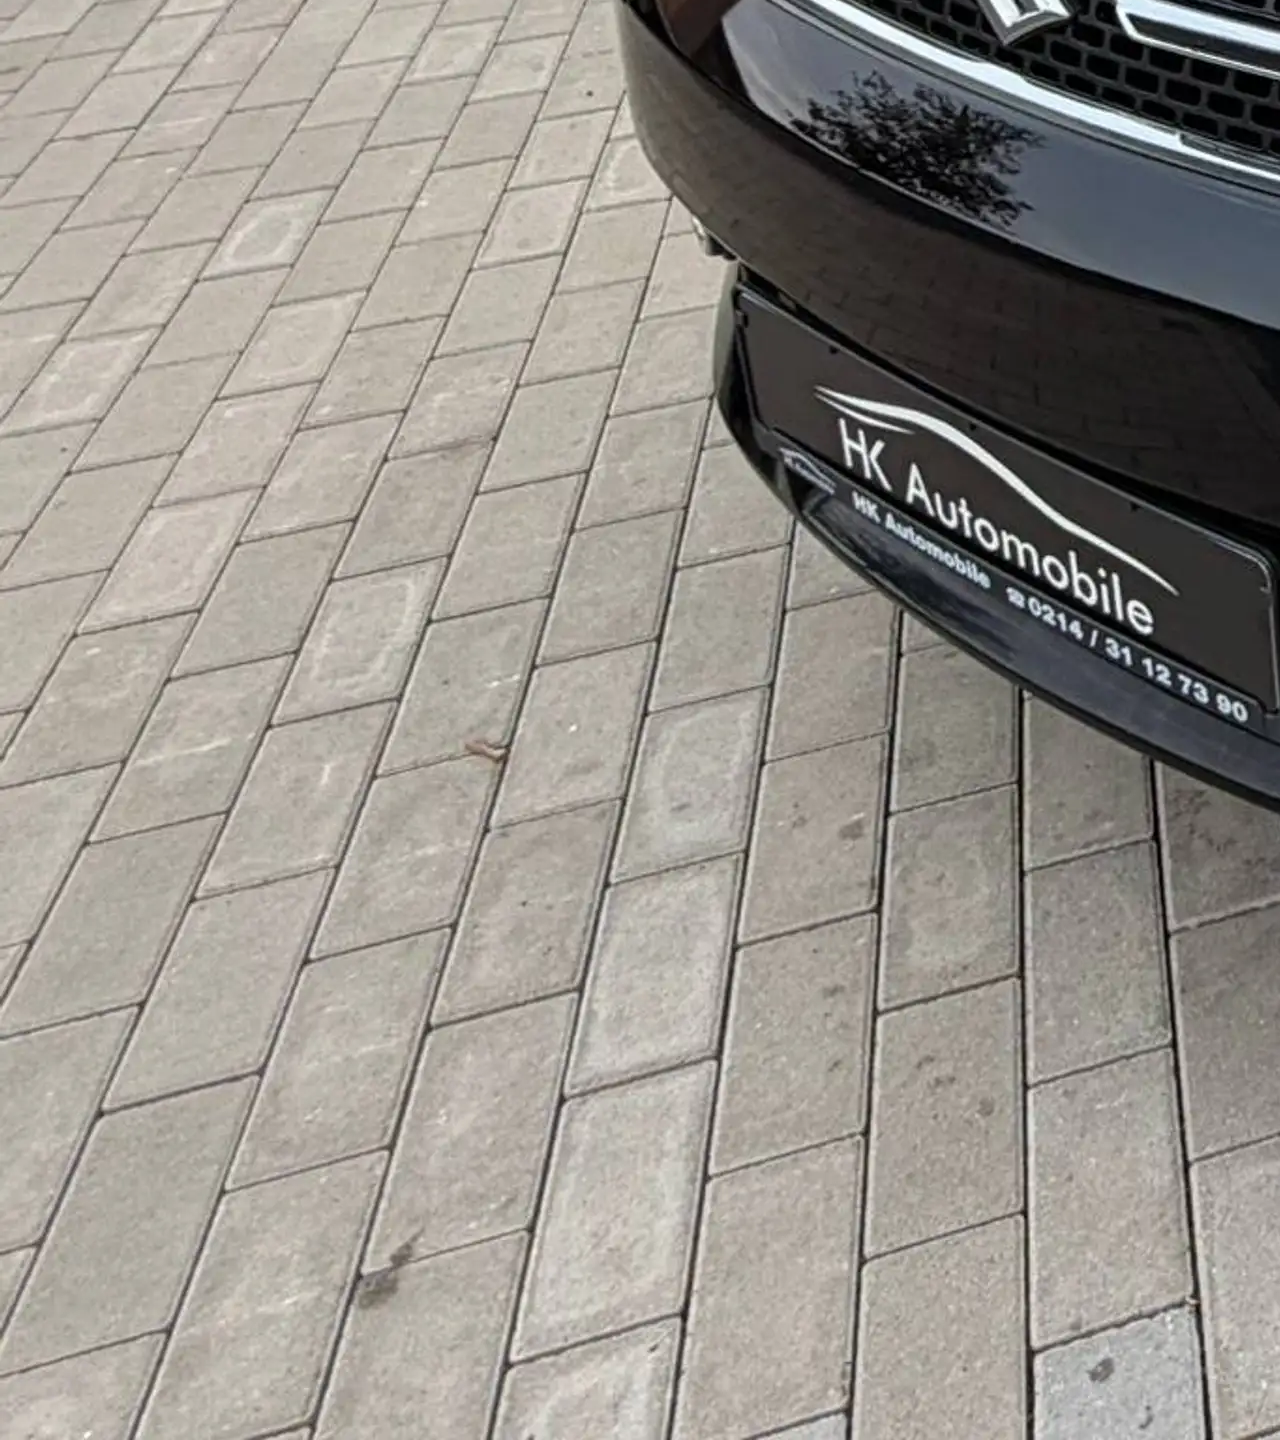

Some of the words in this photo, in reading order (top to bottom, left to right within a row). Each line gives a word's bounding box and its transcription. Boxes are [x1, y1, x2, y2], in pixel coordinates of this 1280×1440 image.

[838, 418, 893, 492] HK
[906, 462, 1154, 636] Automobile
[852, 491, 881, 523] HK
[885, 513, 992, 590] Automobile
[1027, 597, 1083, 642] 0214
[1105, 637, 1133, 668] 31
[1141, 655, 1173, 687] 12
[1179, 673, 1210, 706] 73
[1215, 692, 1250, 724] 90
